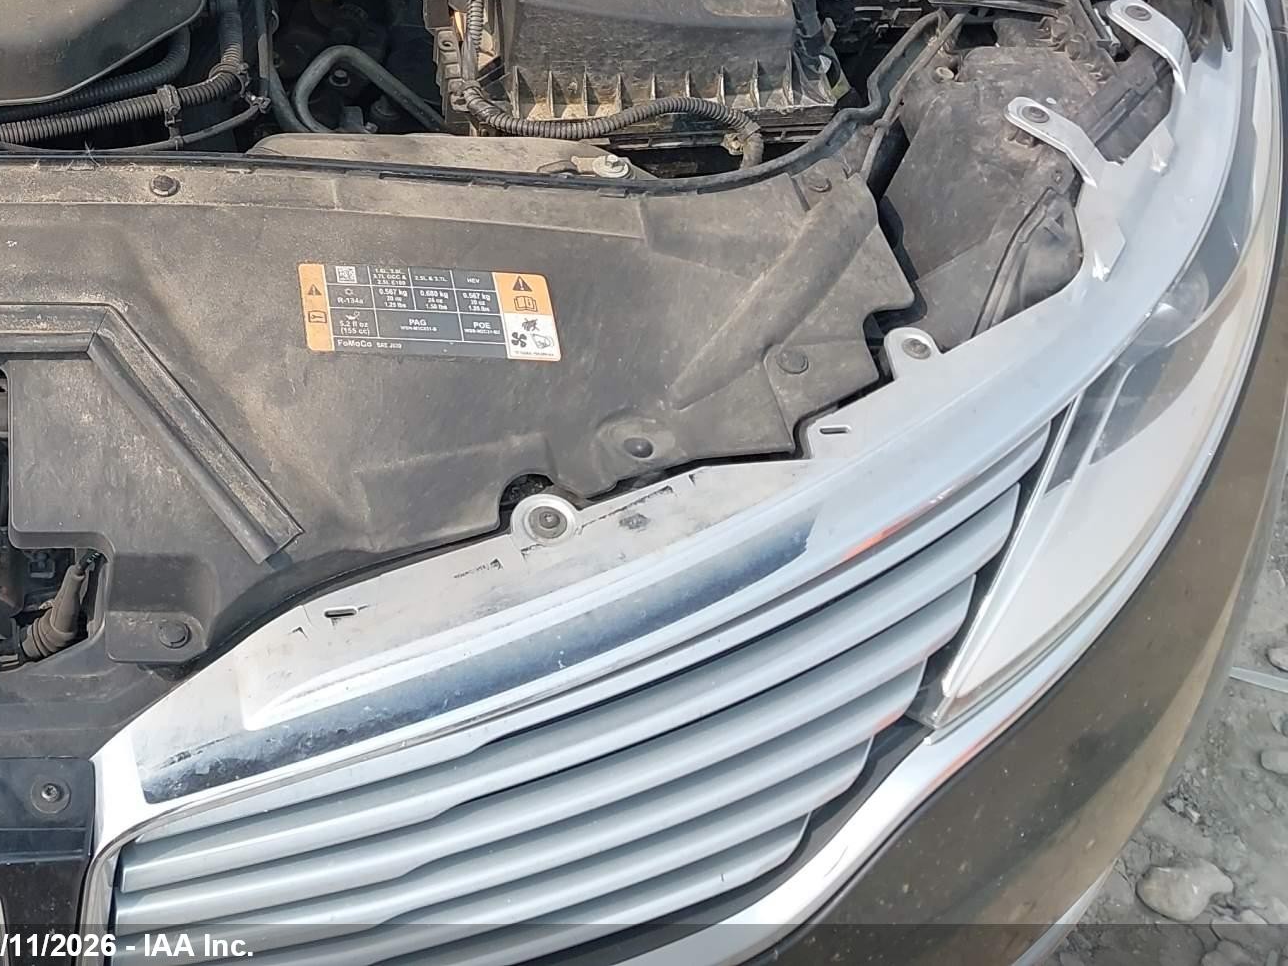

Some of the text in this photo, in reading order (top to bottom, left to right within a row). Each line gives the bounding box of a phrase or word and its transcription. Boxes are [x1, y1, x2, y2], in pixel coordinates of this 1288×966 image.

[398, 289, 408, 297] kg
[439, 290, 449, 299] kg
[481, 293, 491, 302] kg
[408, 318, 428, 326] PAG
[473, 321, 491, 329] POE
[337, 339, 373, 348] FoMoCo
